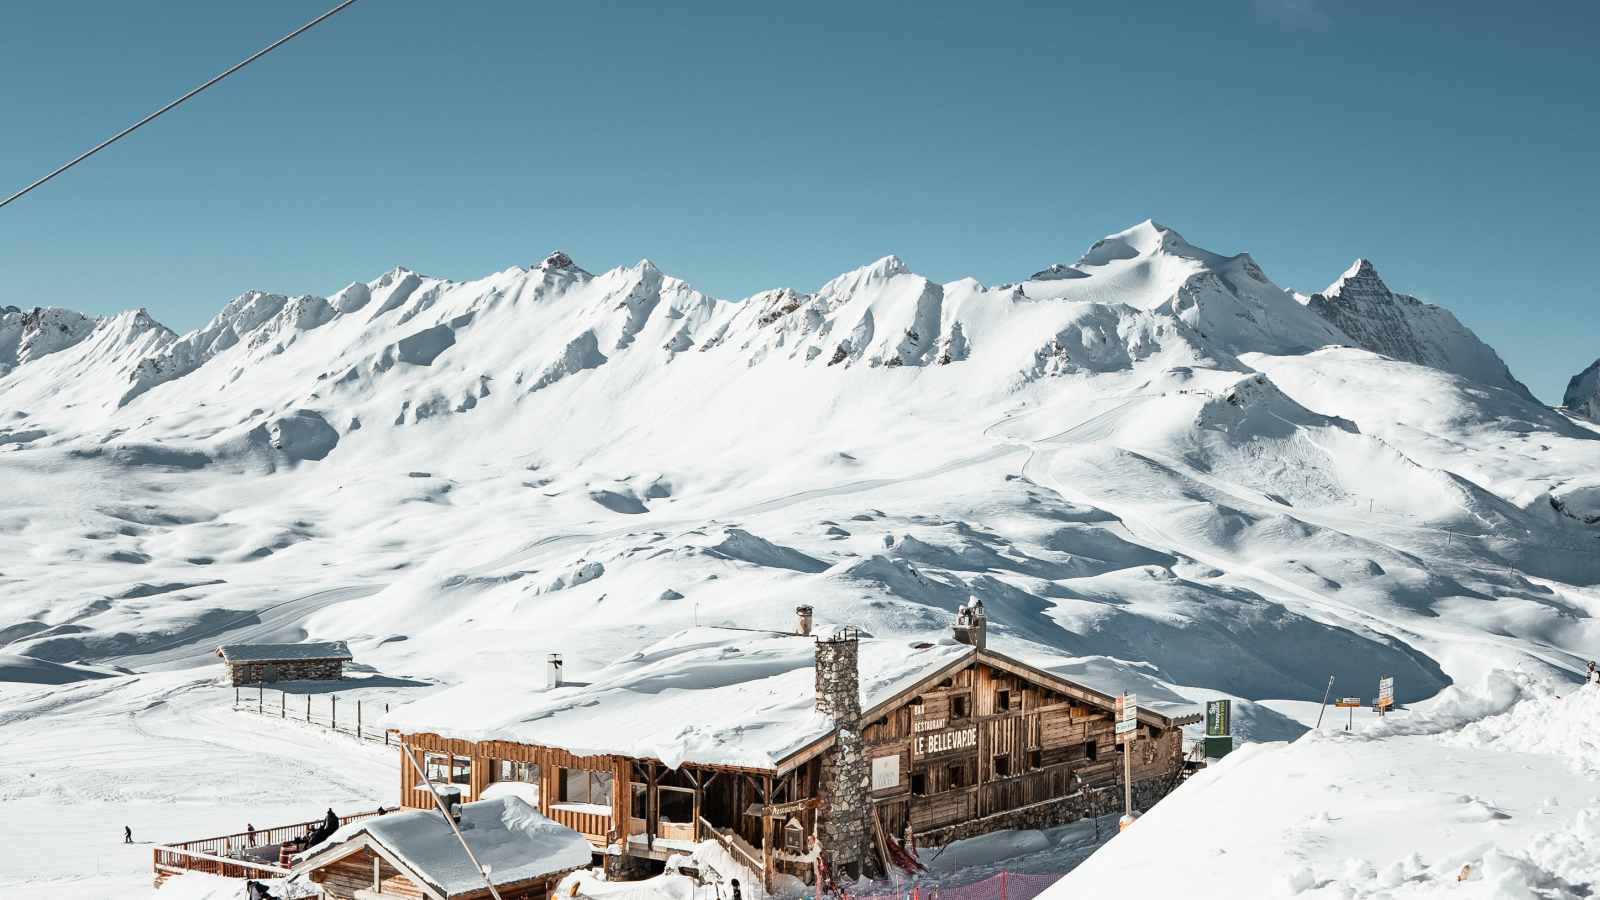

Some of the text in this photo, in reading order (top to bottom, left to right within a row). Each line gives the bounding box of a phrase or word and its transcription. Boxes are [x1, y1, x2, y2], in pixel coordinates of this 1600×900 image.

[914, 705, 925, 715] BAR
[914, 718, 946, 733] RESTAURANT
[914, 728, 977, 755] LE BELLEVARDE
